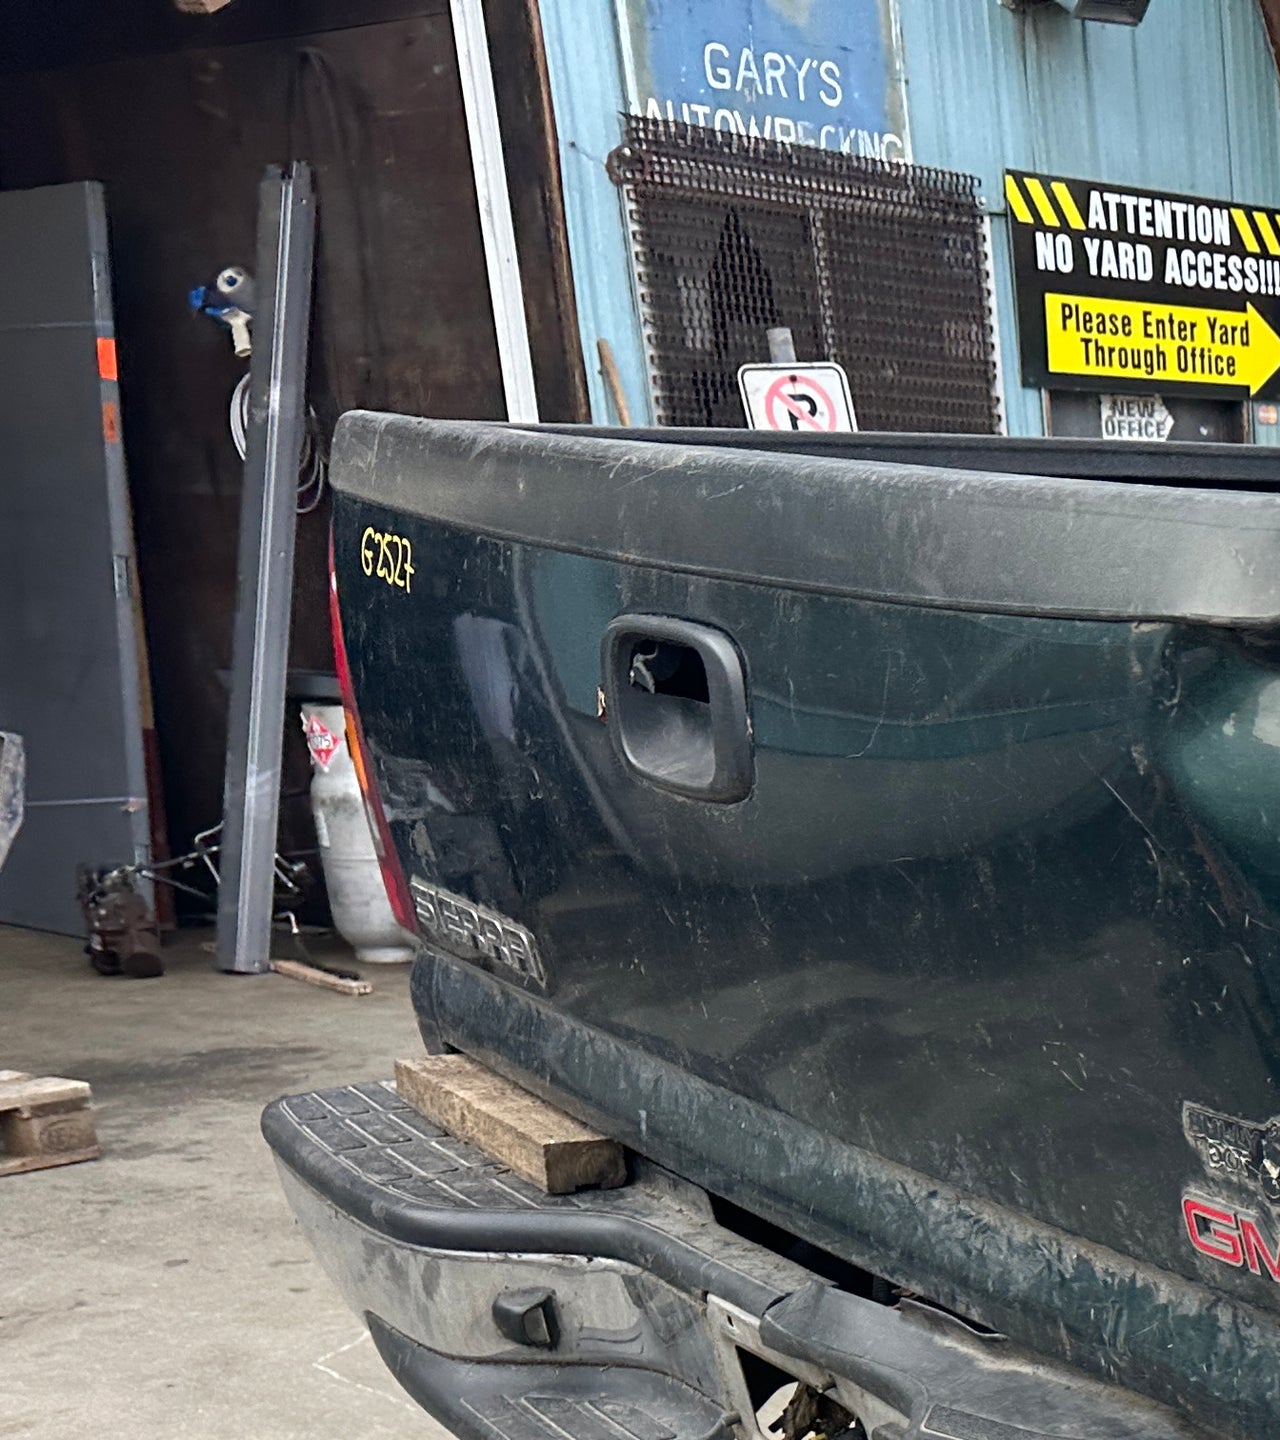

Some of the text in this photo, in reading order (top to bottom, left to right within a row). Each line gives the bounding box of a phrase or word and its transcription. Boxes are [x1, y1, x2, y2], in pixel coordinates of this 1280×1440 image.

[704, 41, 844, 108] GARY'S
[1087, 190, 1232, 247] ATTENTION
[1034, 230, 1074, 274] NO
[1083, 237, 1154, 282] YARD
[1060, 302, 1251, 348] Please Enter Yard
[1080, 337, 1237, 378] Through Office
[1104, 416, 1167, 439] OFFICE
[1111, 399, 1157, 419] NEW
[360, 526, 415, 594] G2527
[410, 874, 547, 990] SIERRA
